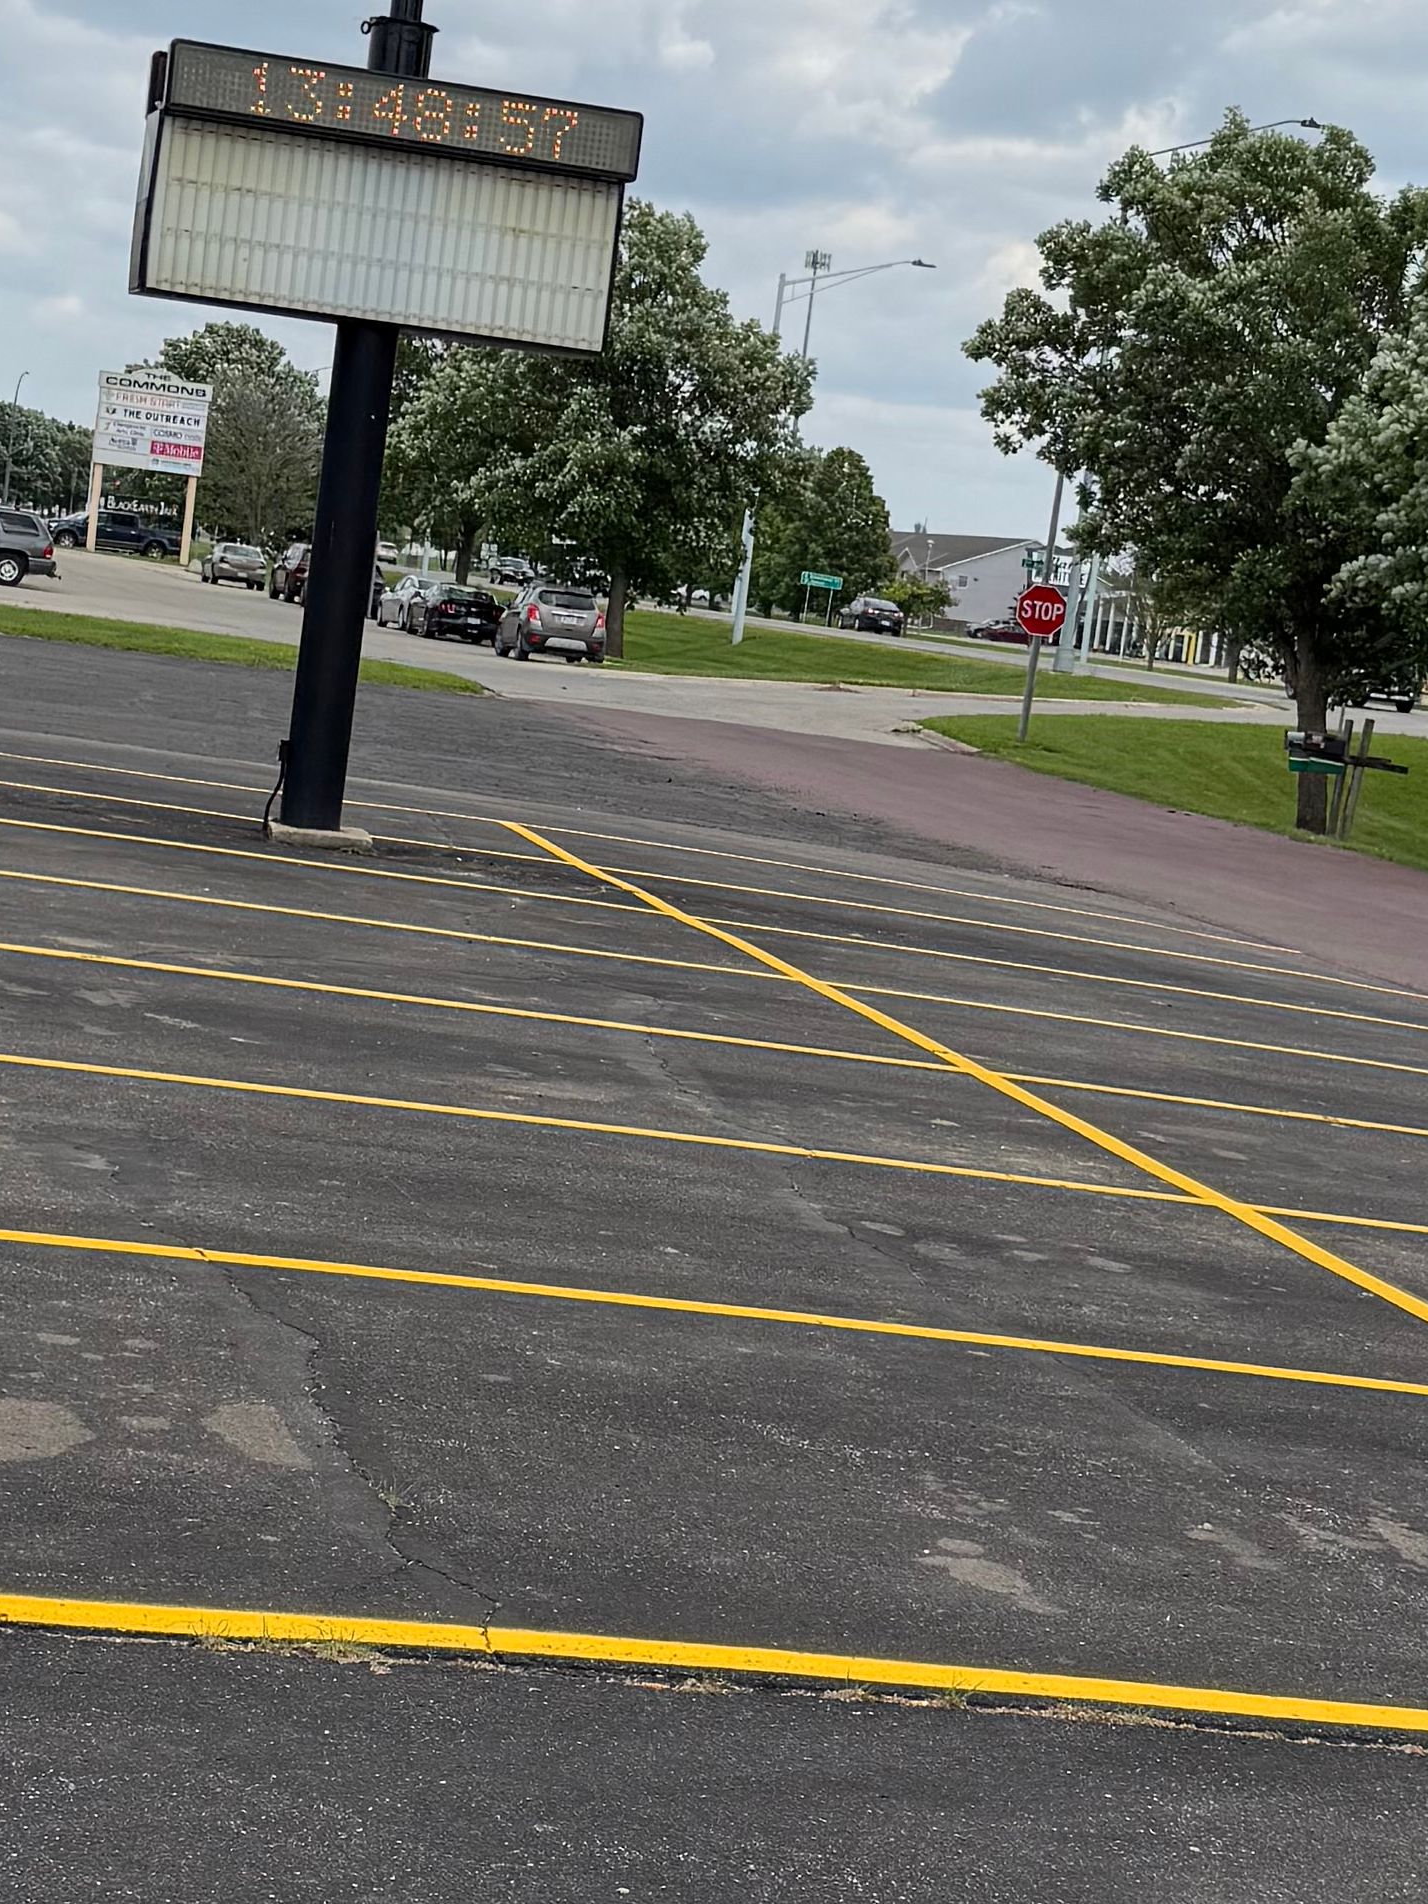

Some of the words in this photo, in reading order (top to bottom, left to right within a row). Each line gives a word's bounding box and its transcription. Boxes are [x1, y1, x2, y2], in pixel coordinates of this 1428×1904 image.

[250, 61, 579, 160] 13:48:57
[105, 376, 207, 398] COMMONS
[144, 372, 172, 382] THE
[123, 408, 142, 420] THE
[145, 410, 201, 427] OUTREACH
[1021, 599, 1064, 622] STOP
